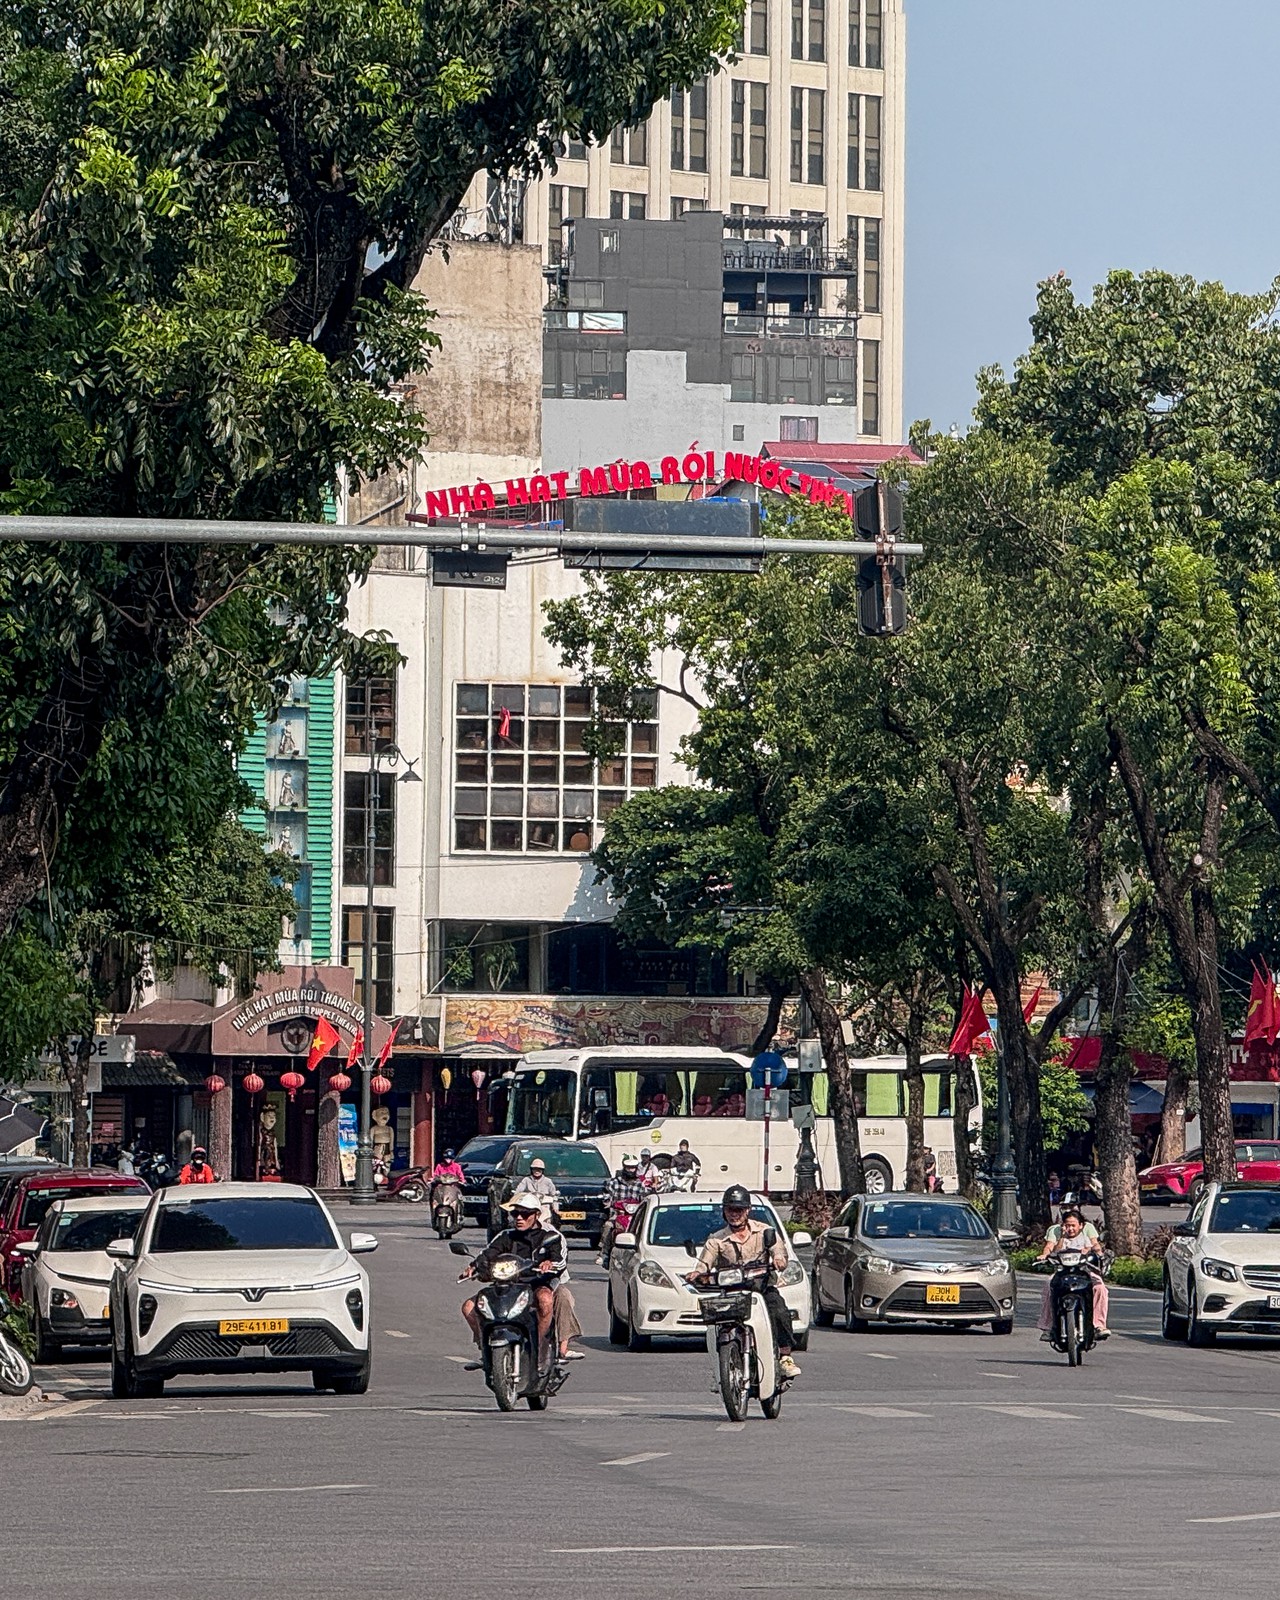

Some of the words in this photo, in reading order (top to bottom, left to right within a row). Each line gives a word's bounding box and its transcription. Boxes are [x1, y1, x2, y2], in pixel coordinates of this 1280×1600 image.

[425, 477, 496, 518] NHÀ
[505, 468, 570, 506] HÁT
[579, 458, 652, 496] MÚA
[661, 440, 715, 484] RỐI
[246, 1017, 268, 1036] THANG
[268, 1008, 287, 1022] LONG
[287, 1006, 310, 1016] WATER
[310, 1006, 335, 1020] PUPPET
[335, 1015, 357, 1037] THEATR
[69, 1041, 108, 1057] JDE
[936, 1286, 951, 1294] 30H
